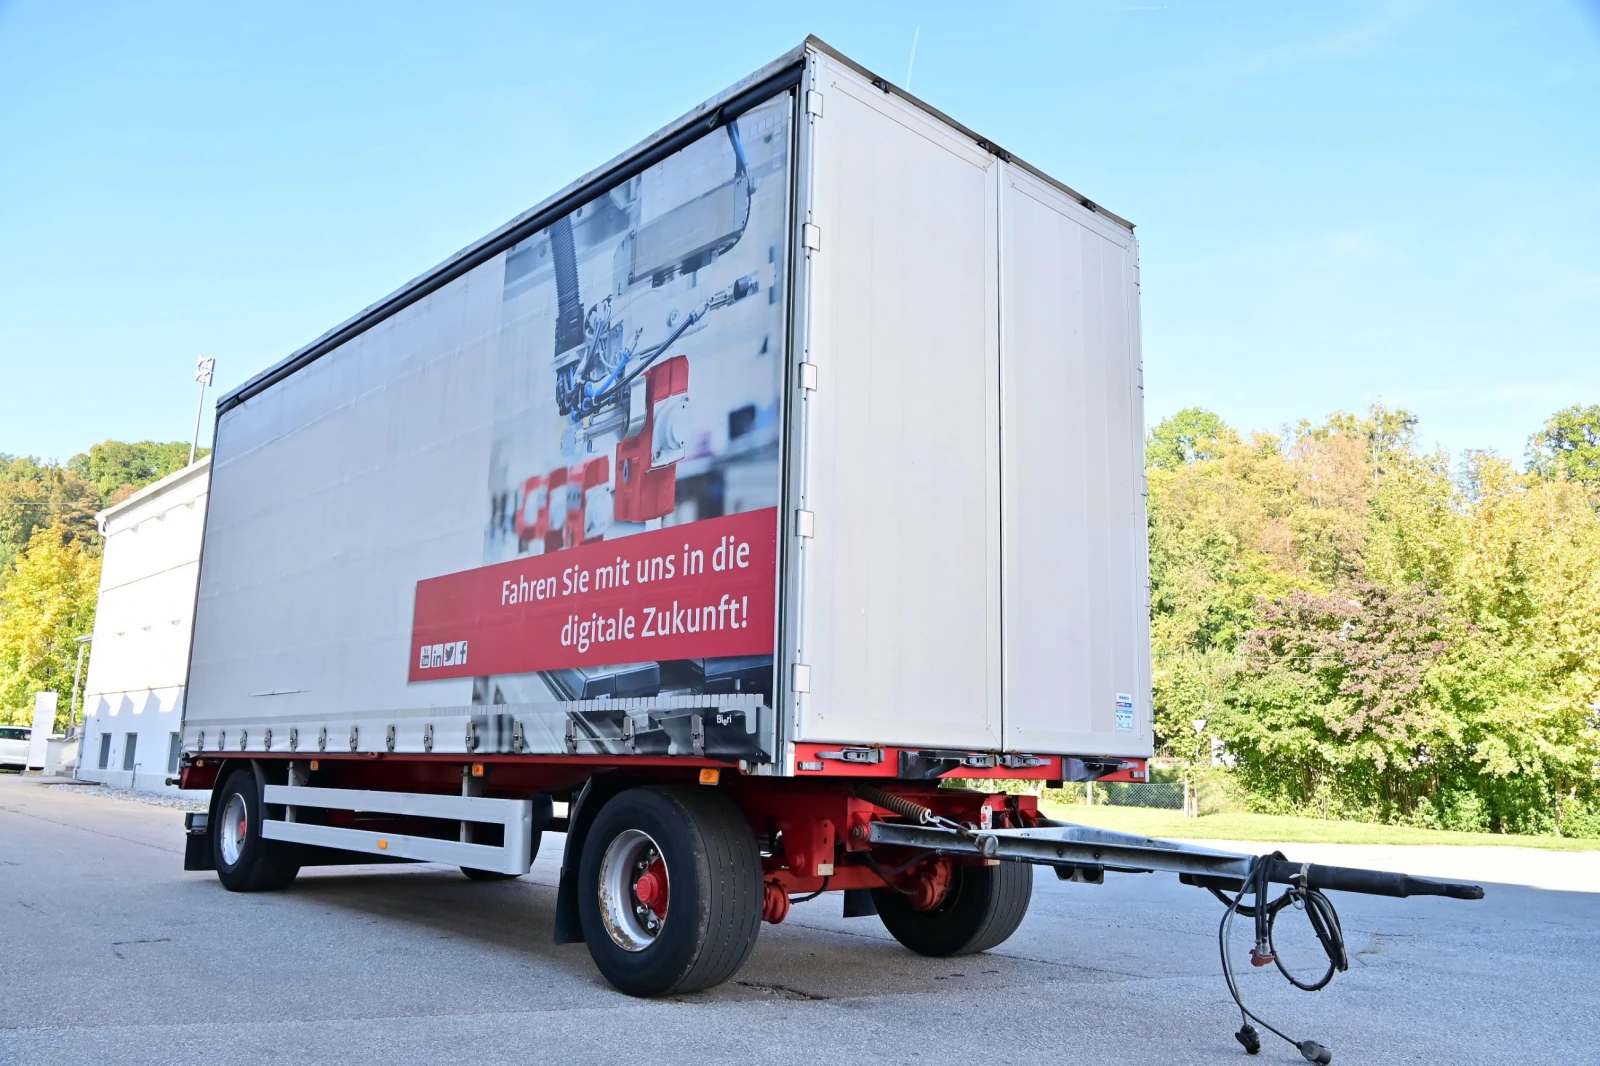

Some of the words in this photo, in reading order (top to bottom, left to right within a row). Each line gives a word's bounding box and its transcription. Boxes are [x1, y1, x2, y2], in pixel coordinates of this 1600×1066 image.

[501, 574, 557, 606] Fahren
[562, 564, 590, 596] Sie
[595, 556, 630, 590] mit
[637, 554, 676, 583] uns
[683, 543, 704, 576] in
[712, 535, 750, 572] die
[560, 608, 636, 653] digitale
[641, 594, 748, 637] Zukunft!
[716, 714, 732, 726] Bieri
